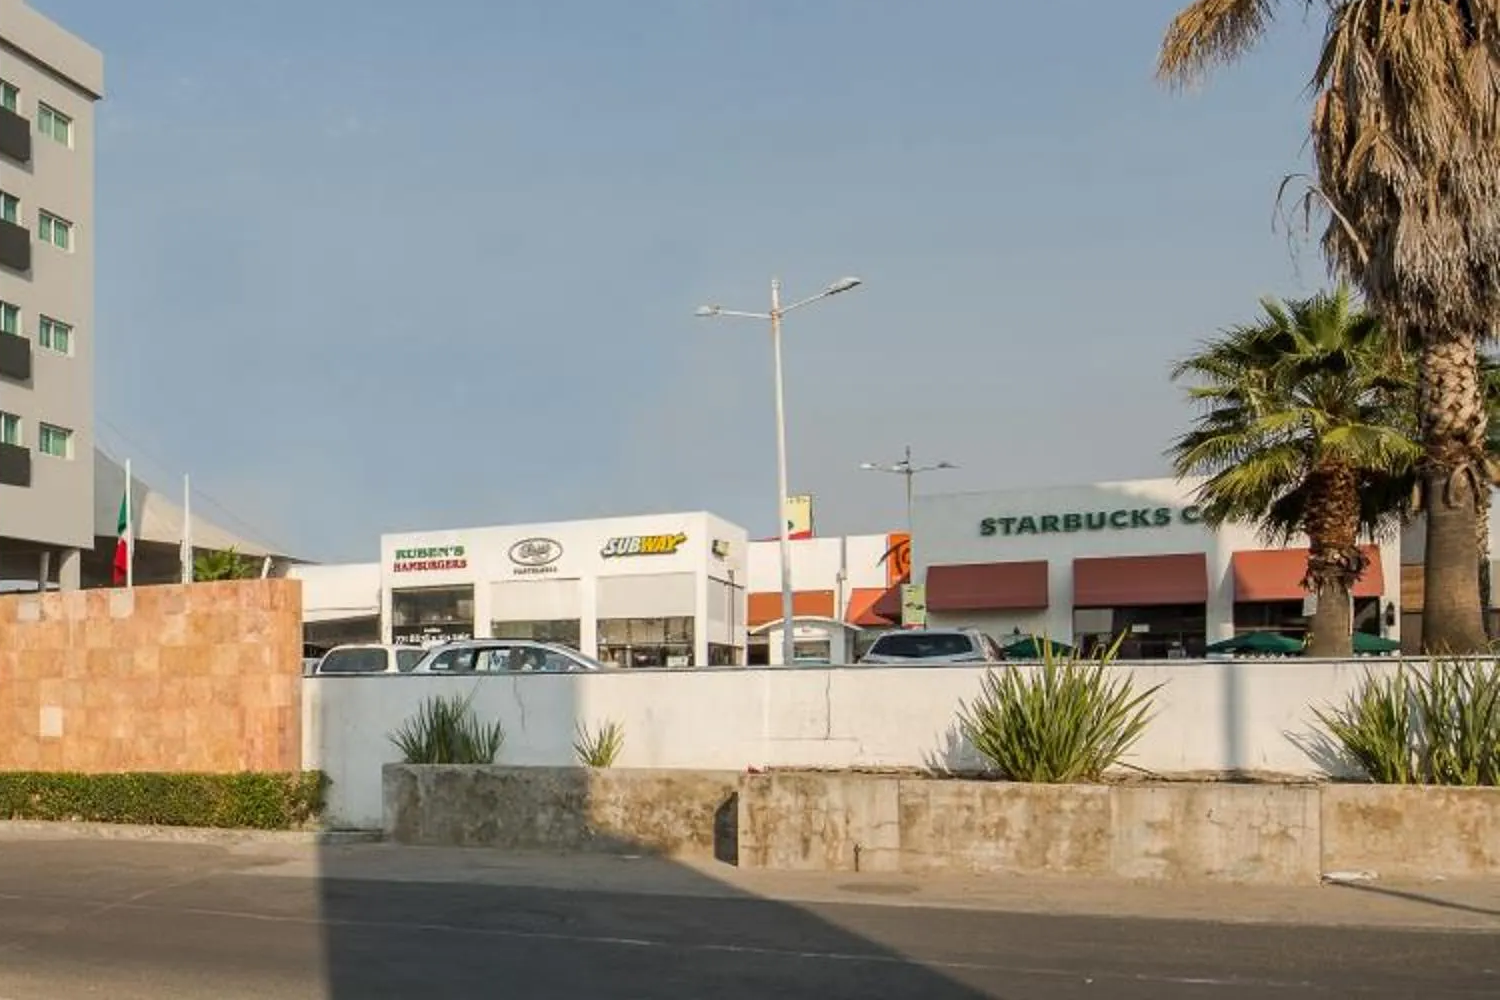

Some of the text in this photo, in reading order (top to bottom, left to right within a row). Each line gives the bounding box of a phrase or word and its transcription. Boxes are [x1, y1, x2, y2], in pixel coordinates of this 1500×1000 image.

[980, 506, 1172, 536] STARBUCKS
[601, 532, 688, 558] SUBWAY
[393, 560, 467, 573] HAMBURGERS
